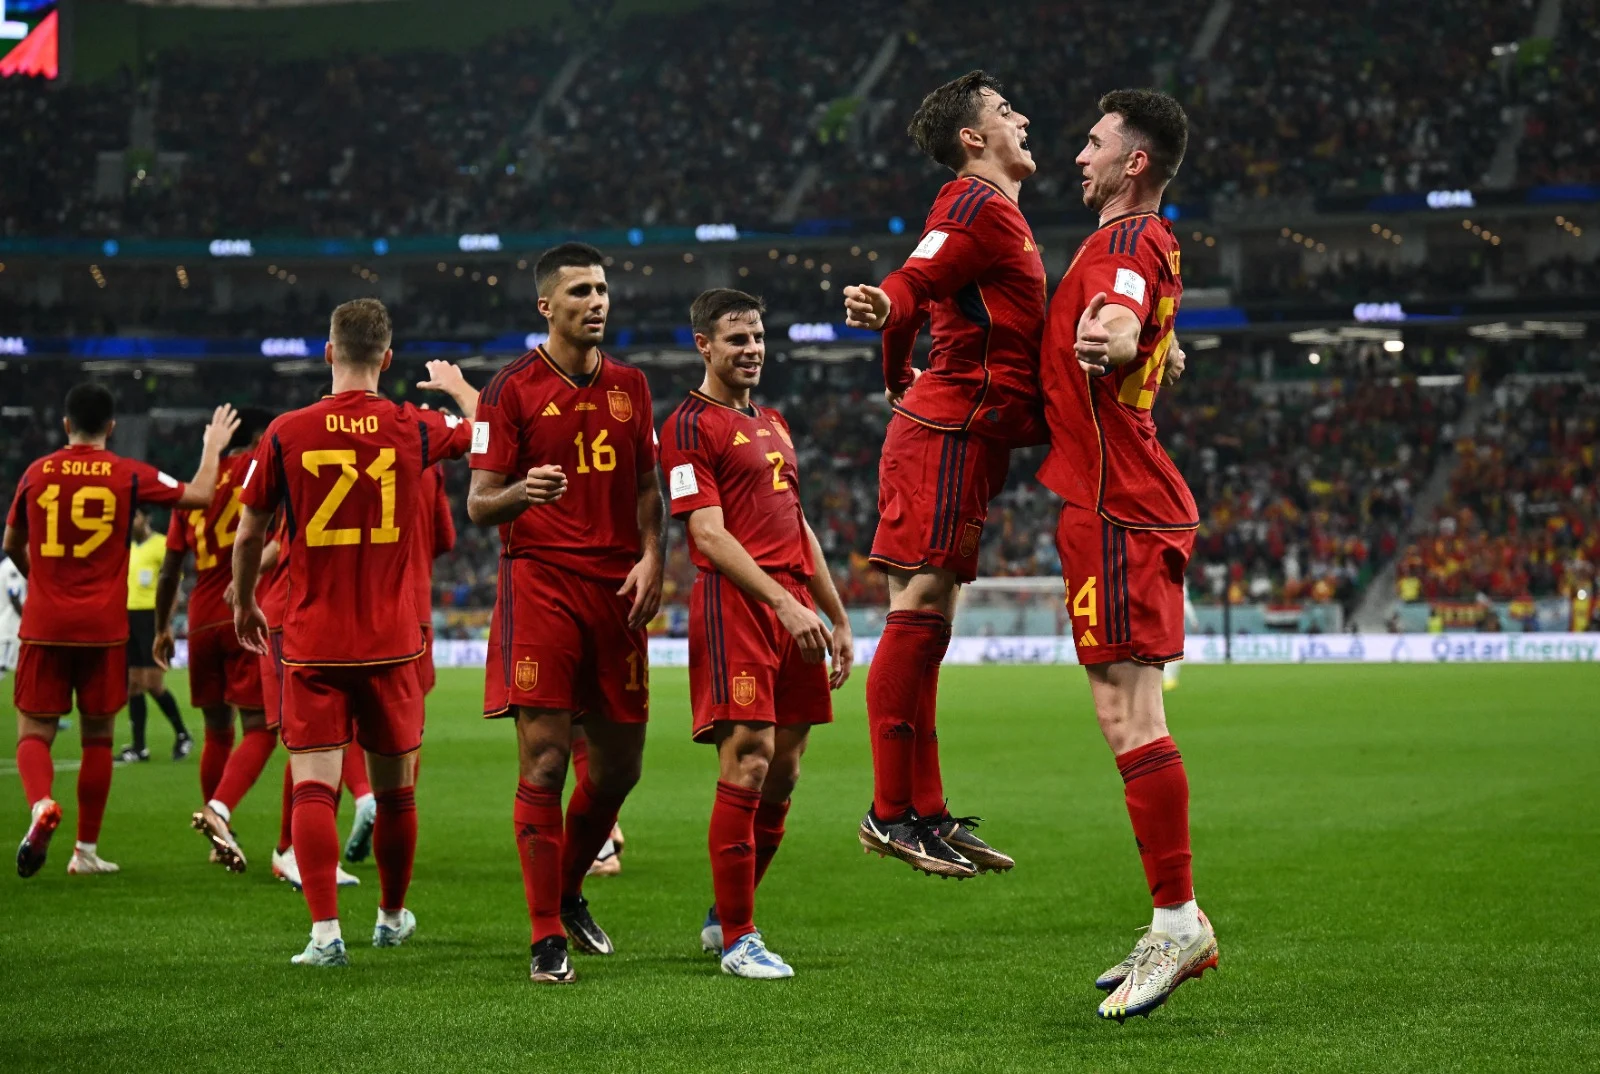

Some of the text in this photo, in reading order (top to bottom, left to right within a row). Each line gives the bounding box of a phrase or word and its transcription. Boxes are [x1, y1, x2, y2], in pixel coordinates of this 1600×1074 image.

[325, 413, 379, 434] OLMO
[42, 460, 113, 476] C. SOLER
[574, 429, 617, 474] 16
[765, 452, 790, 491] 2
[302, 447, 400, 547] 21
[37, 484, 117, 558] 19
[188, 485, 244, 571] 14
[1064, 575, 1099, 627] 4
[1432, 636, 1598, 662] QatarEnergy
